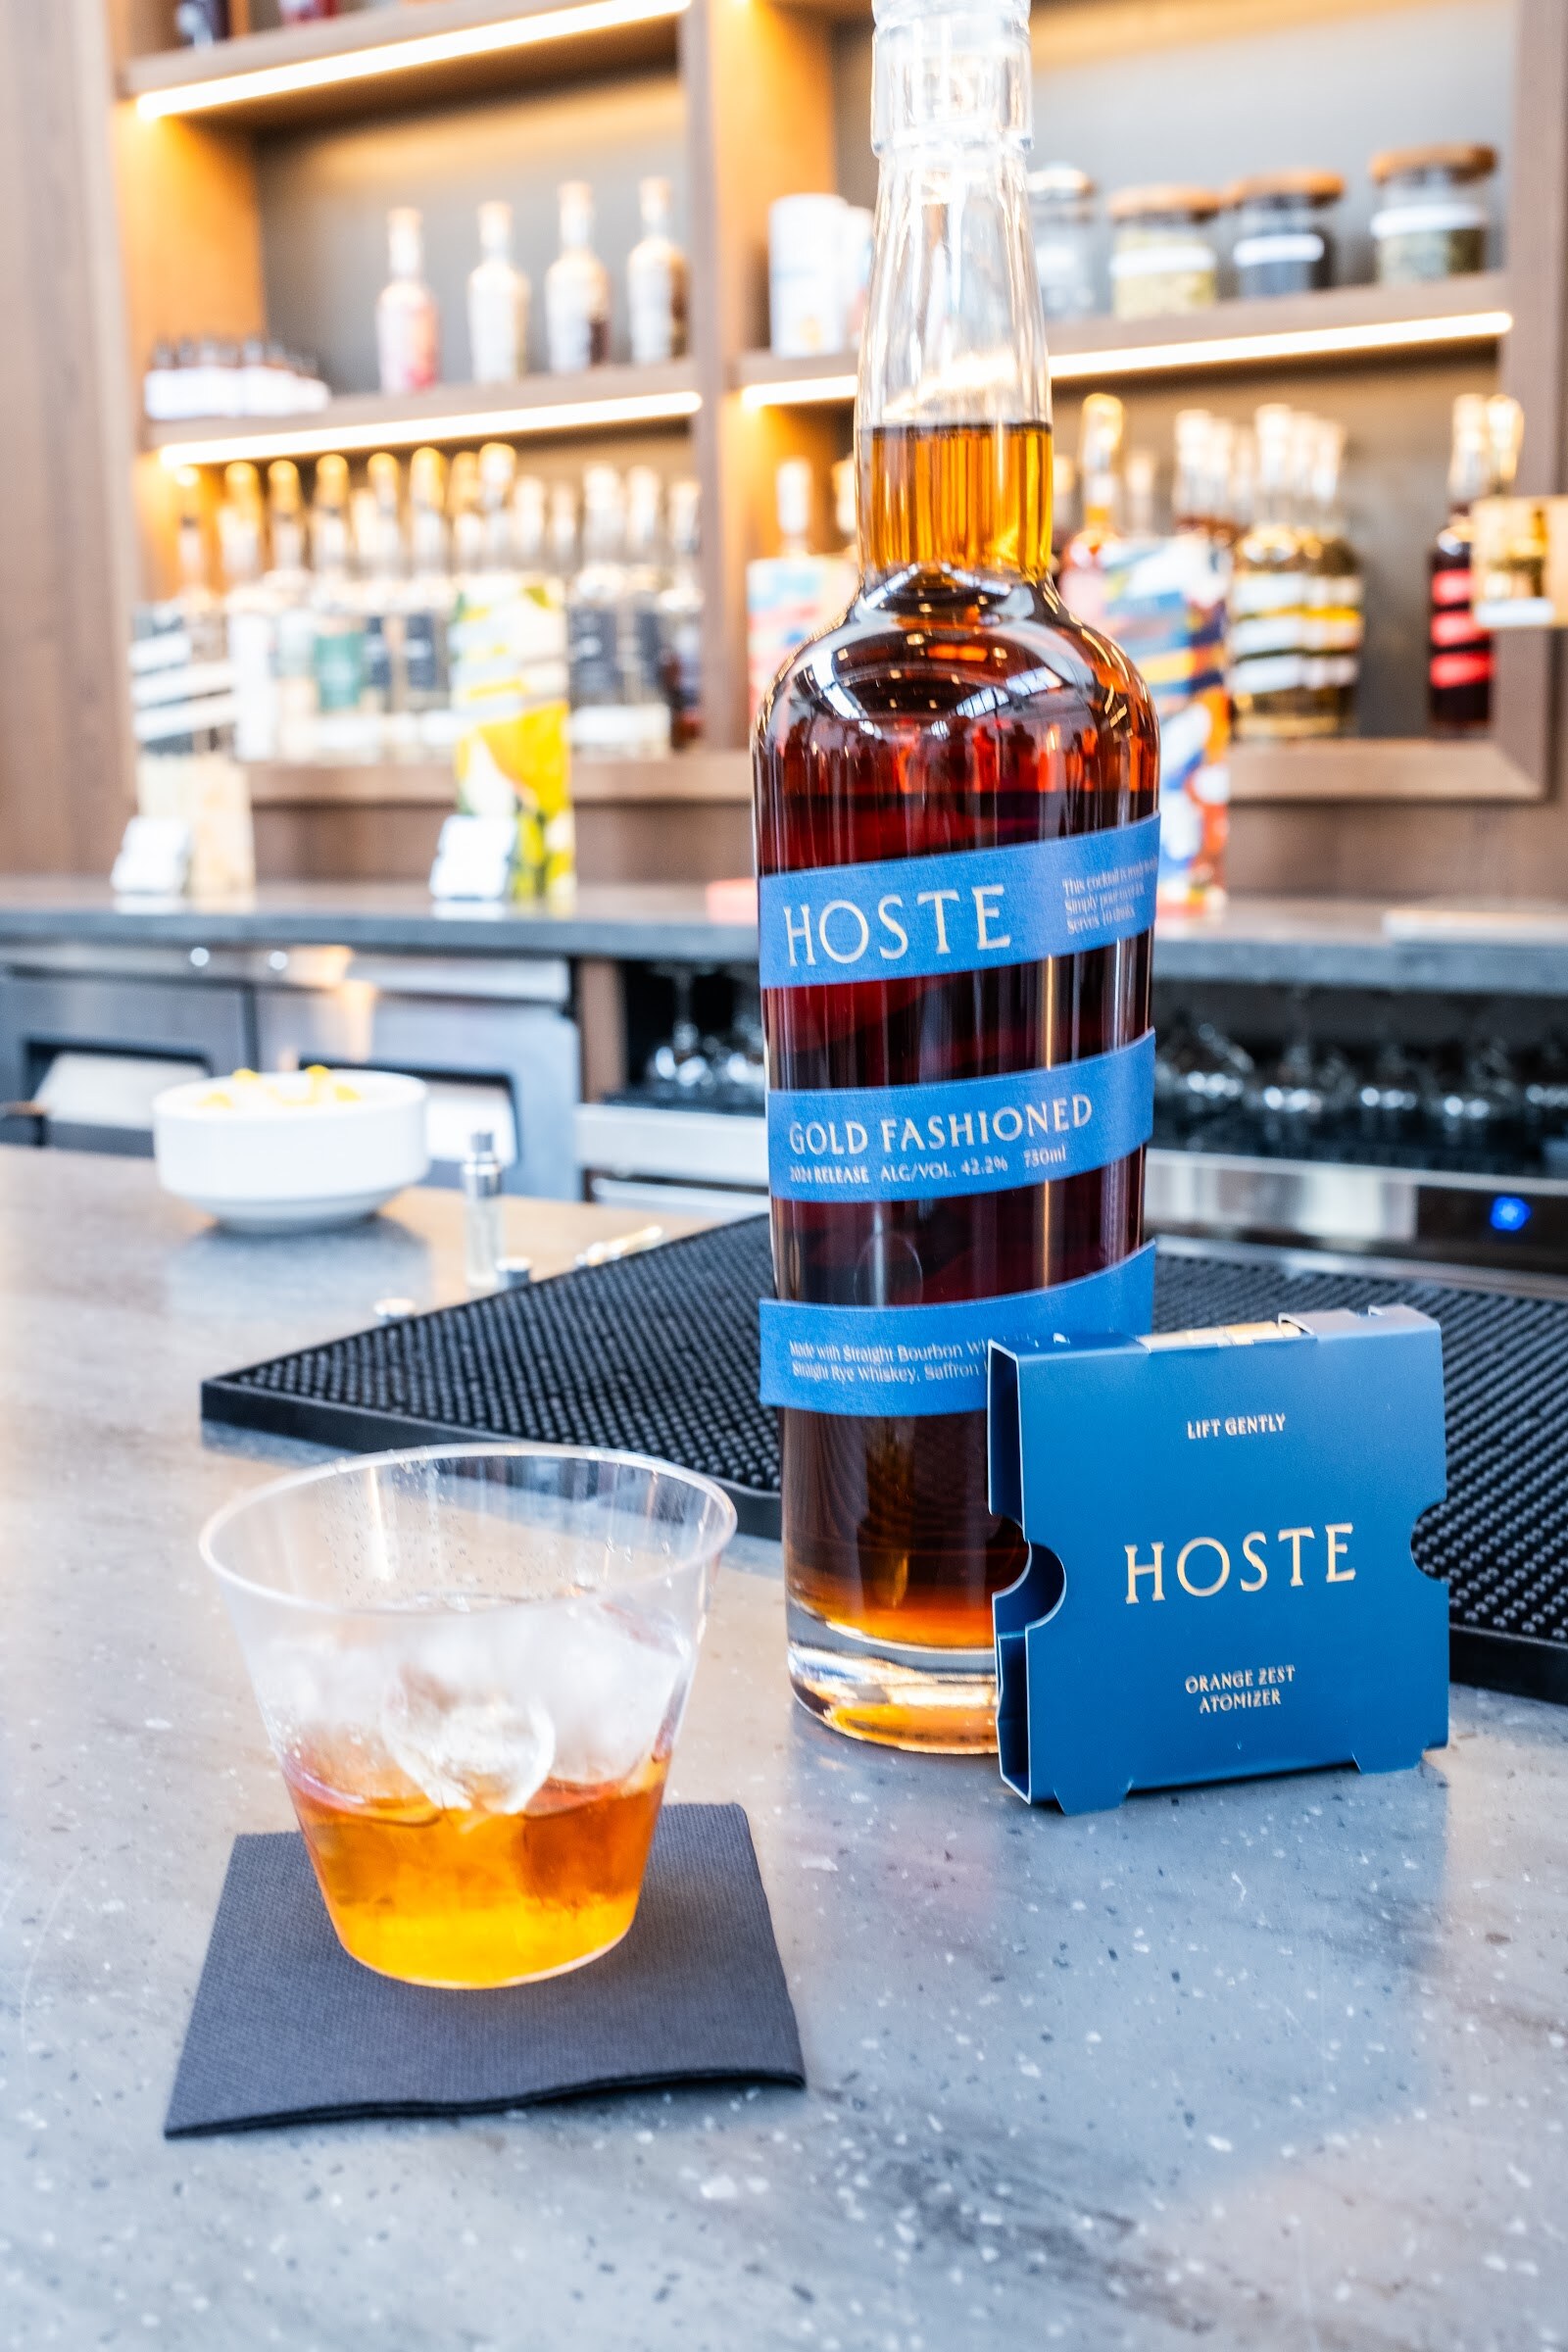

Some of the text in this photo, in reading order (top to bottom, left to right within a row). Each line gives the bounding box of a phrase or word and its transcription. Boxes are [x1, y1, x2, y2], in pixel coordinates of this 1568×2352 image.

[783, 884, 1011, 968] HOSTE
[789, 1093, 1093, 1155] GOLD FASHIONED
[813, 1164, 869, 1184] RELEASE
[960, 1154, 1009, 1176] 42.2%
[1023, 1144, 1067, 1168] 750ml
[815, 1343, 841, 1361] with
[843, 1344, 895, 1365] Straight
[897, 1343, 963, 1363] Bourbon
[831, 1364, 855, 1385] Rye
[923, 1359, 980, 1381] Saffron
[1186, 1412, 1287, 1440] LIFT GENTLY
[1123, 1522, 1357, 1605] HOSTE
[1184, 1664, 1297, 1694] ORANGE ZEST
[1199, 1687, 1282, 1714] ATOMIZER
